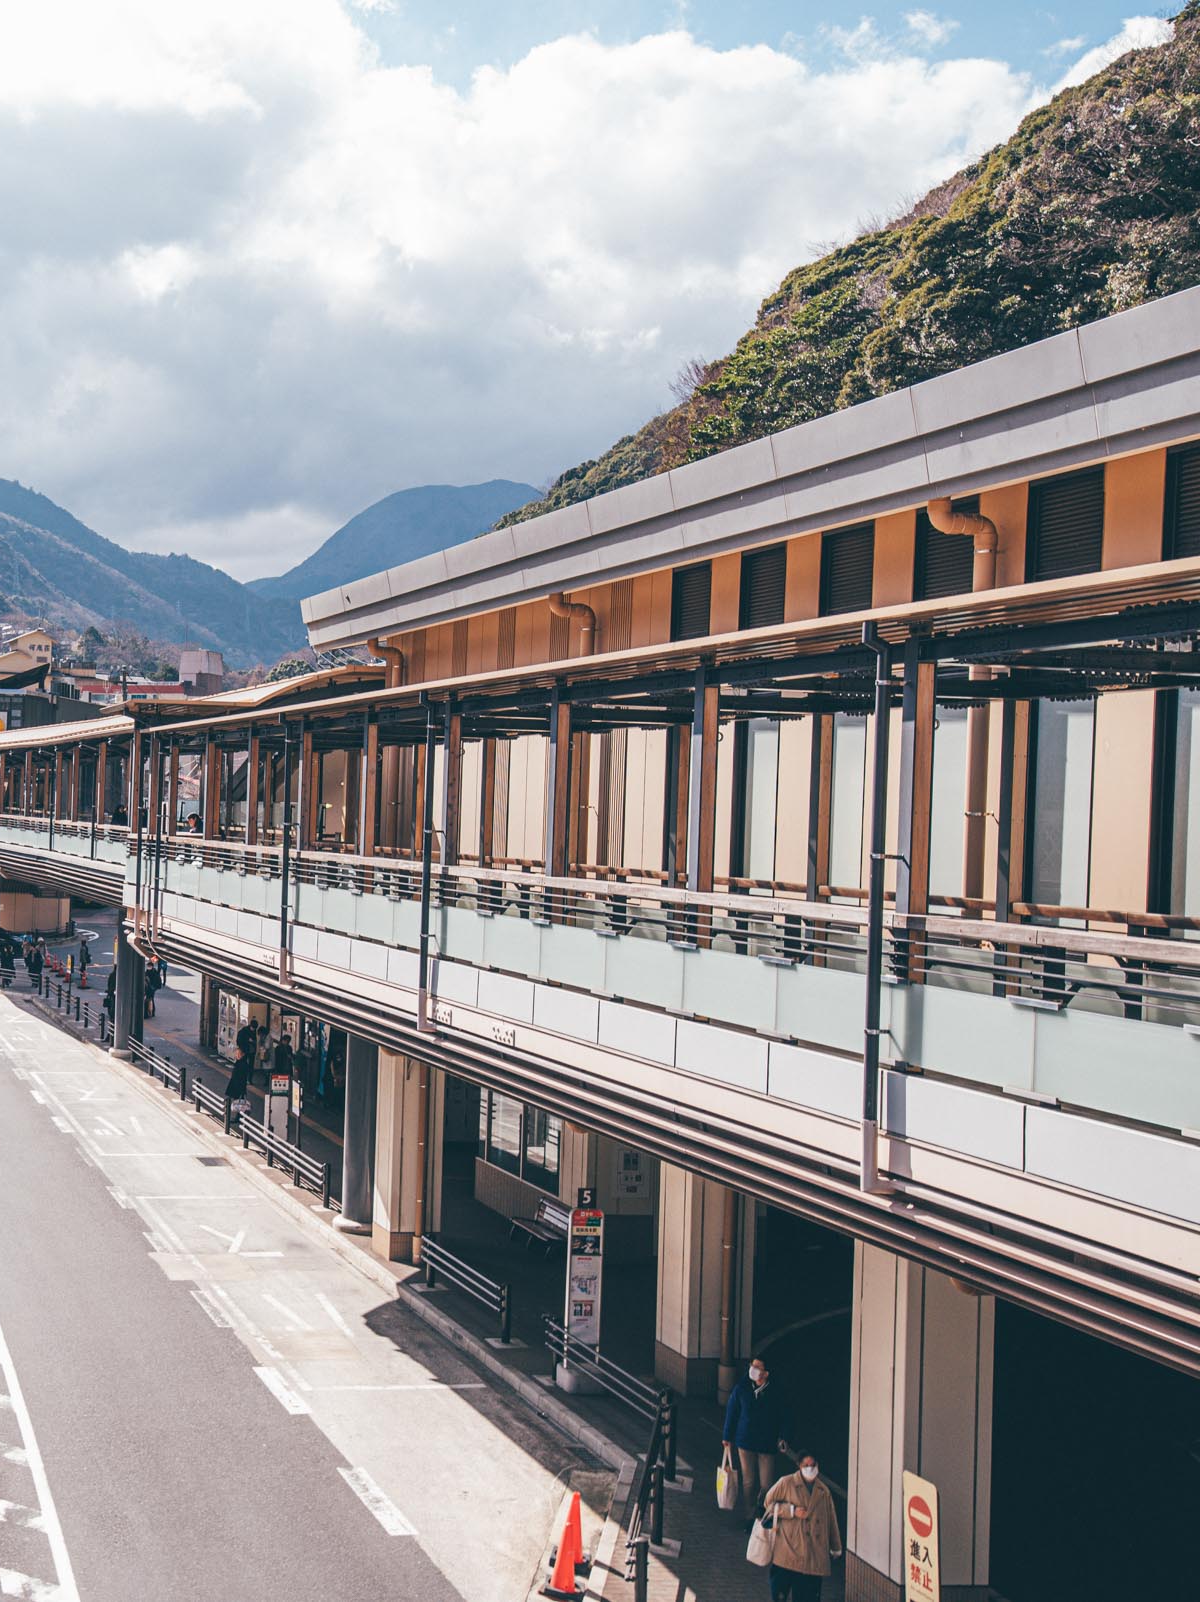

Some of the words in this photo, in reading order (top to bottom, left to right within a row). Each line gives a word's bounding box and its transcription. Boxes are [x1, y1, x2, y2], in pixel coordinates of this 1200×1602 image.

[582, 1190, 592, 1204] 5
[910, 1538, 933, 1568] 進入
[910, 1562, 934, 1593] 禁止
